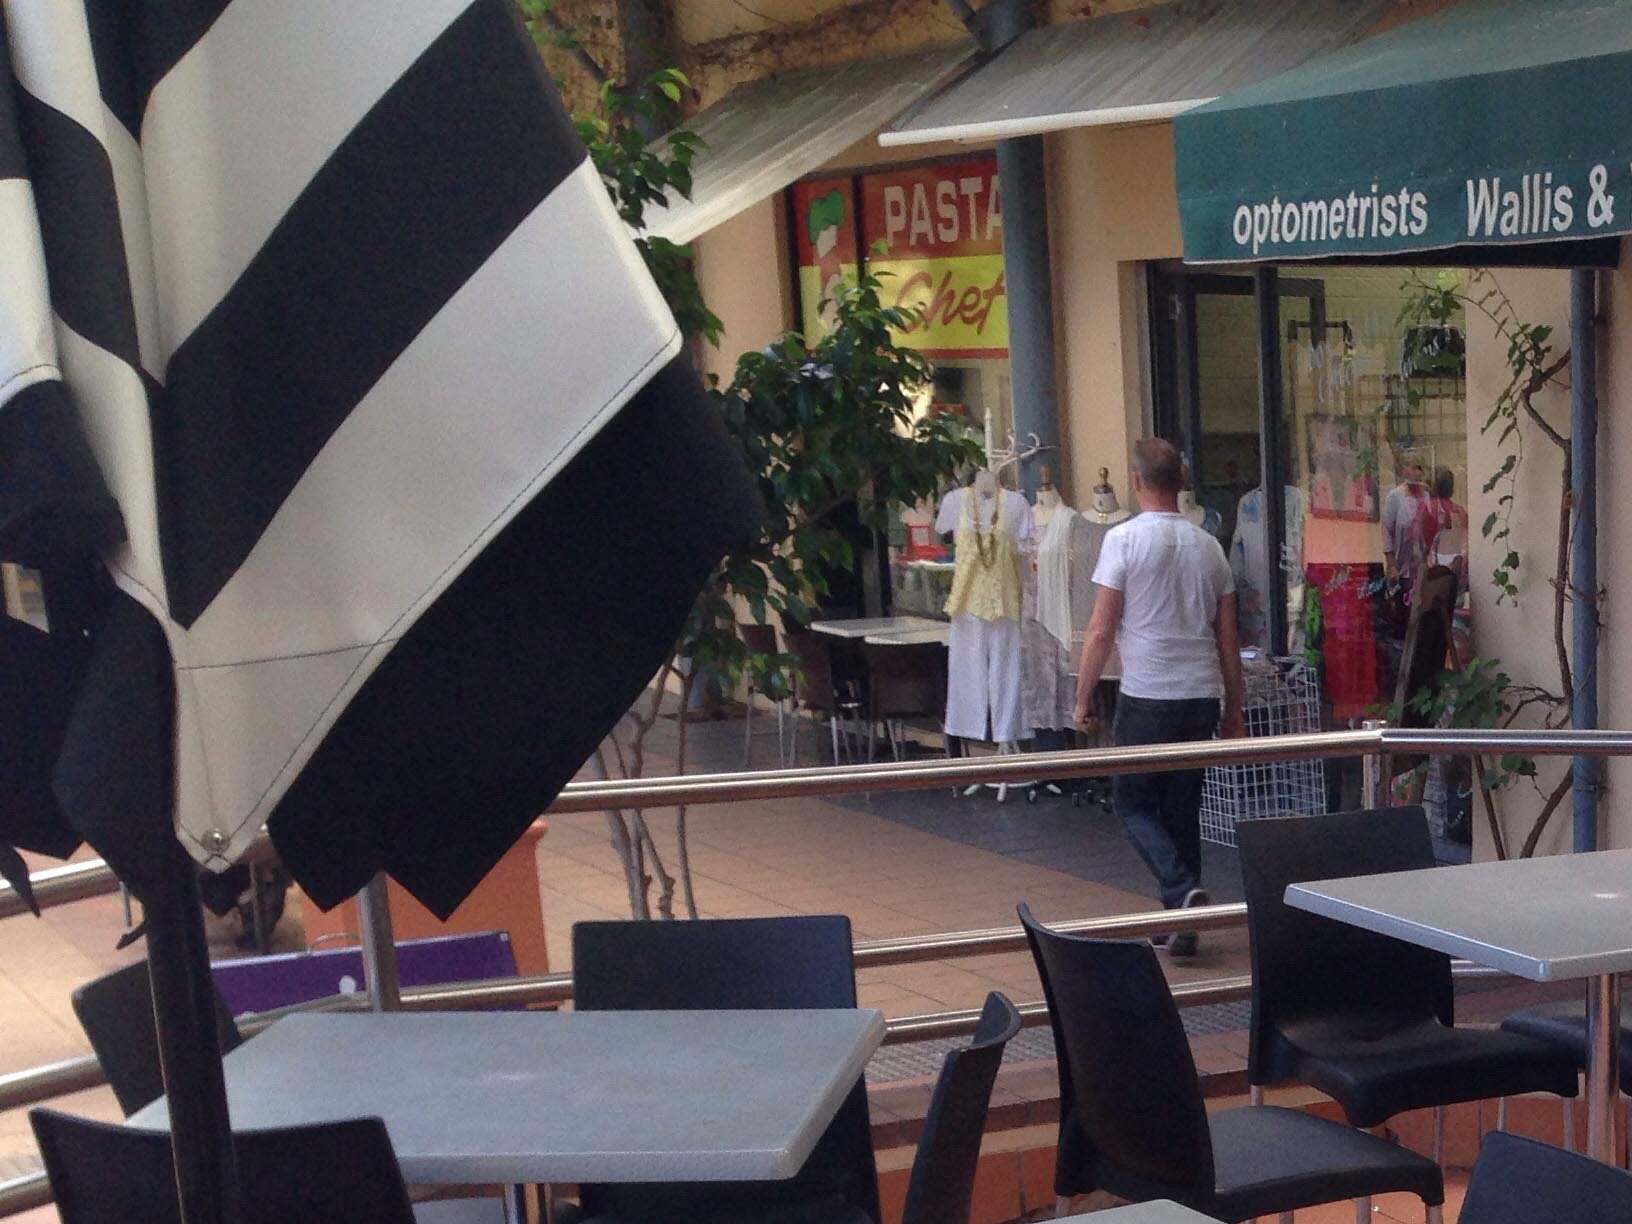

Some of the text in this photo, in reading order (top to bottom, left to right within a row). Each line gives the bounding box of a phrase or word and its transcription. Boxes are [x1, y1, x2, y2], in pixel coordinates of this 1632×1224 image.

[884, 175, 1003, 247] PASTA
[1232, 184, 1429, 254] optometrists
[1466, 172, 1574, 238] Wallis
[1587, 163, 1615, 228] &
[896, 270, 1005, 335] Chef
